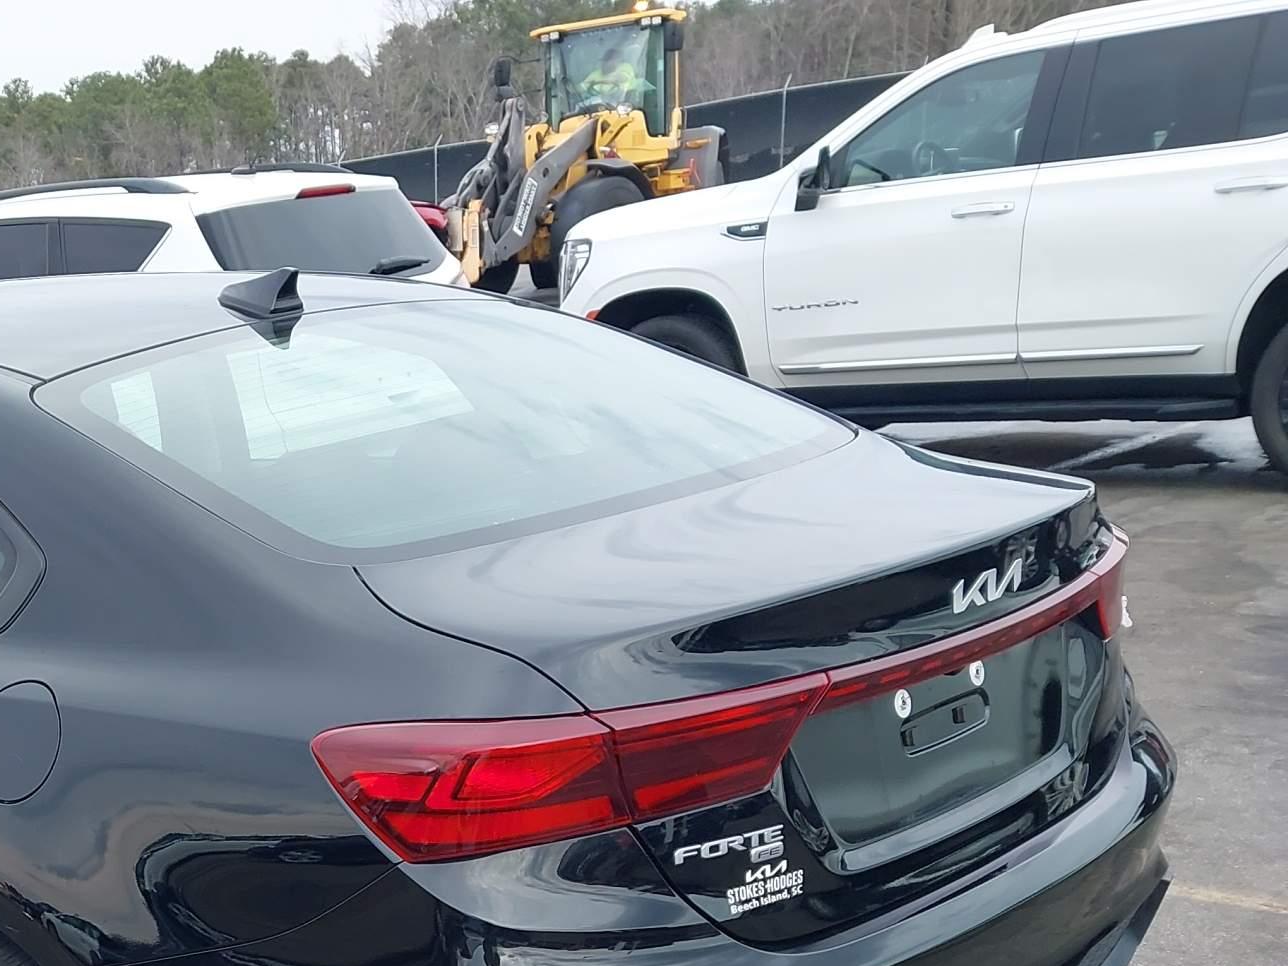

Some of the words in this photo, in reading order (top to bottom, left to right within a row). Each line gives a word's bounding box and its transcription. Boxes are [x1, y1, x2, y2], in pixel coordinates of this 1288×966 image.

[674, 824, 784, 865] FORTE
[730, 898, 760, 915] Beech
[761, 890, 791, 906] Island,
[792, 884, 804, 897] SC
